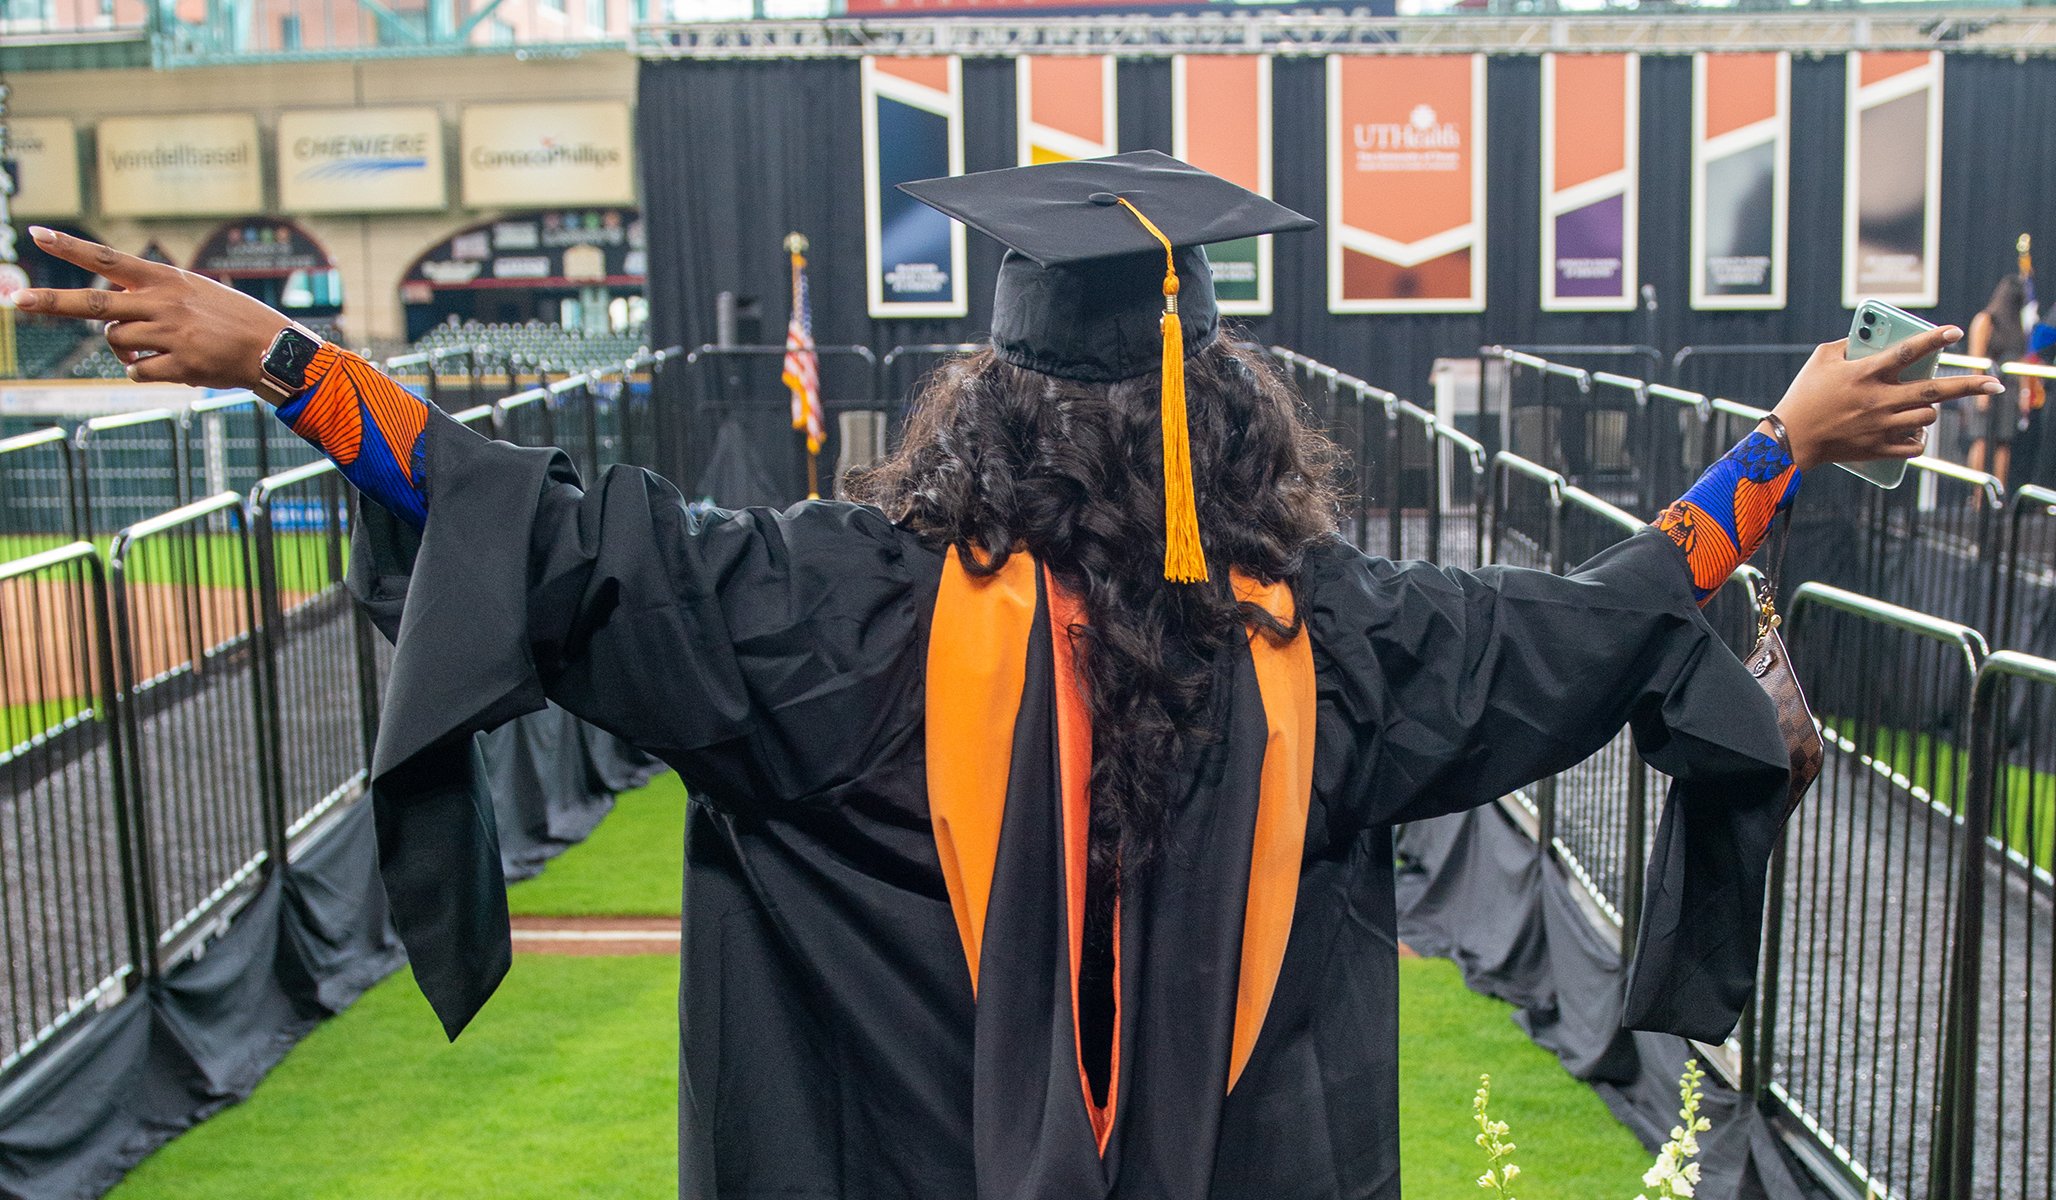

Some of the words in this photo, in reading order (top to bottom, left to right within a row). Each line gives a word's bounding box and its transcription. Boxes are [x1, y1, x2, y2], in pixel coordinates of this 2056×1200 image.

[293, 133, 427, 160] CHENIERE
[1354, 123, 1460, 149] UTHealth
[470, 142, 620, 171] ConocoPhillips
